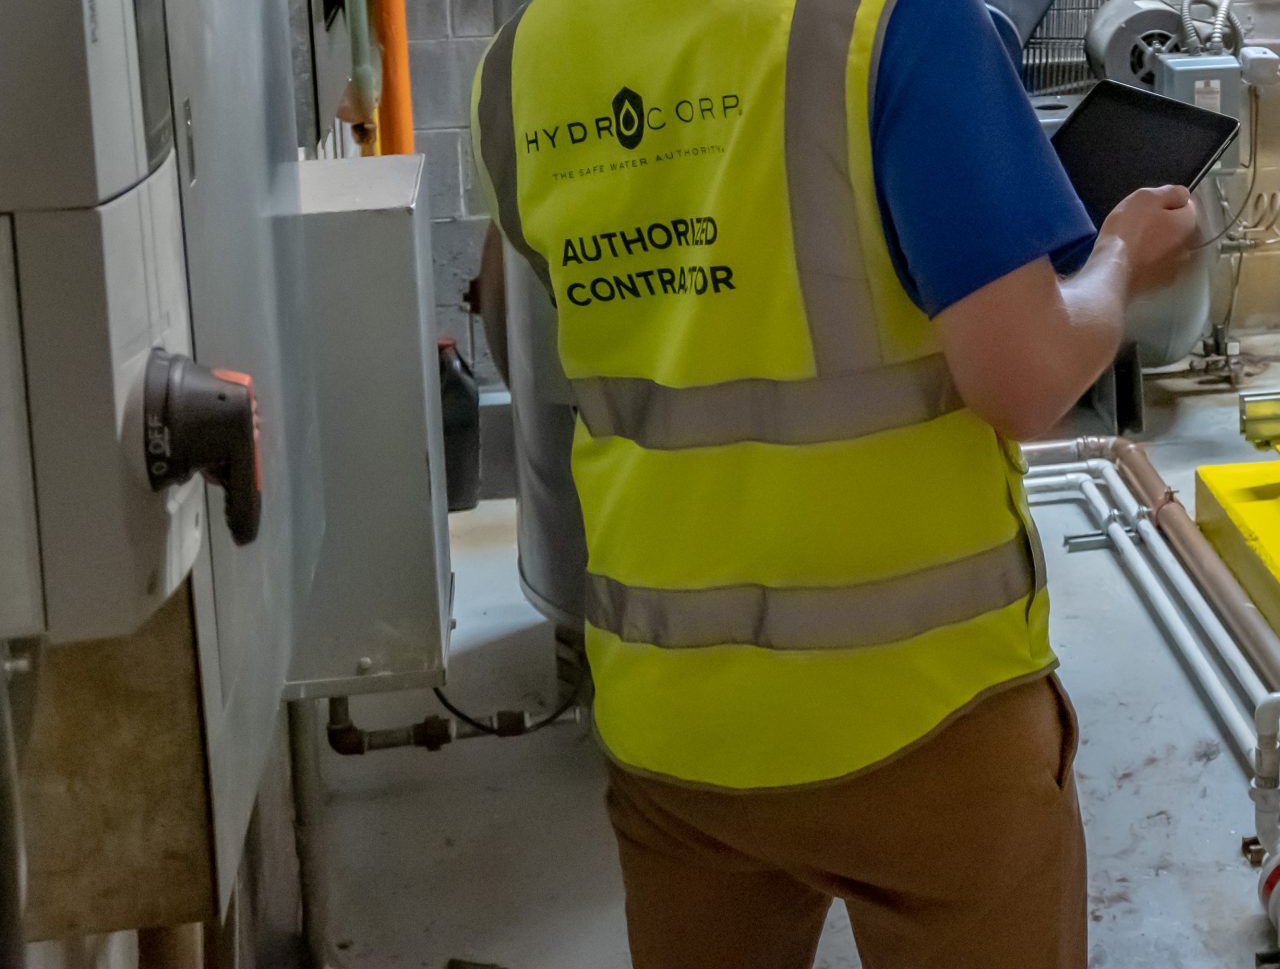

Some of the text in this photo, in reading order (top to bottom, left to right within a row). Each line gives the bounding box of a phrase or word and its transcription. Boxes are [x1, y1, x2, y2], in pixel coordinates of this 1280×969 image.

[553, 170, 575, 181] THE
[578, 164, 605, 177] SAFE
[610, 158, 649, 172] WATER
